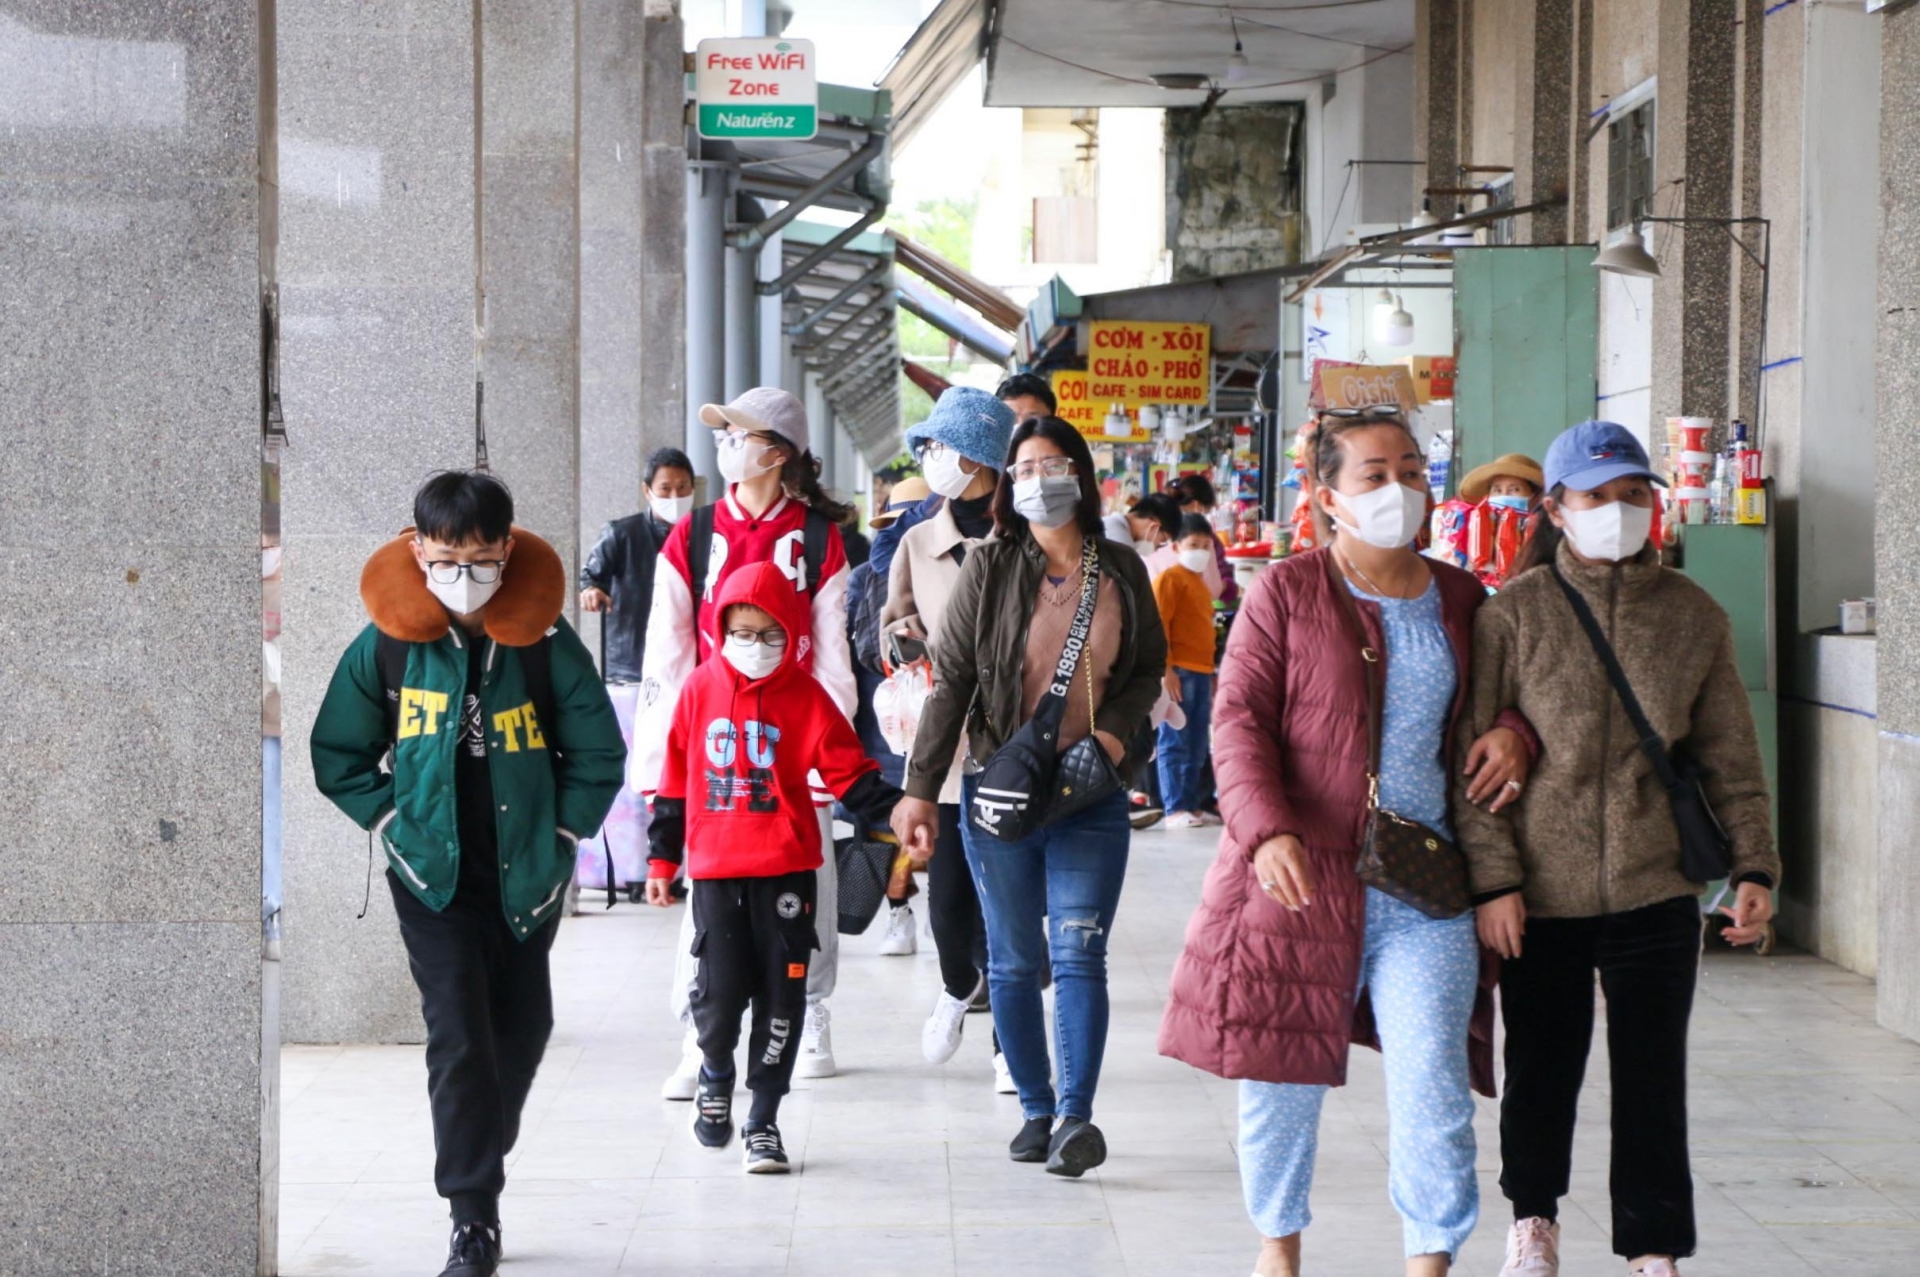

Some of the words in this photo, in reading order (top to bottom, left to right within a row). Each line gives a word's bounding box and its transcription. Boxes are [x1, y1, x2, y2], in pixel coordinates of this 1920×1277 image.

[707, 53, 753, 70] Free
[728, 79, 780, 96] Zone
[1094, 325, 1144, 350] CƠM
[1161, 325, 1204, 352] XÔI
[1092, 383, 1126, 398] CAFE
[1138, 384, 1162, 399] SIM
[1165, 385, 1202, 400] CARD
[1342, 373, 1399, 409] Oishi
[974, 816, 1000, 836] adidas
